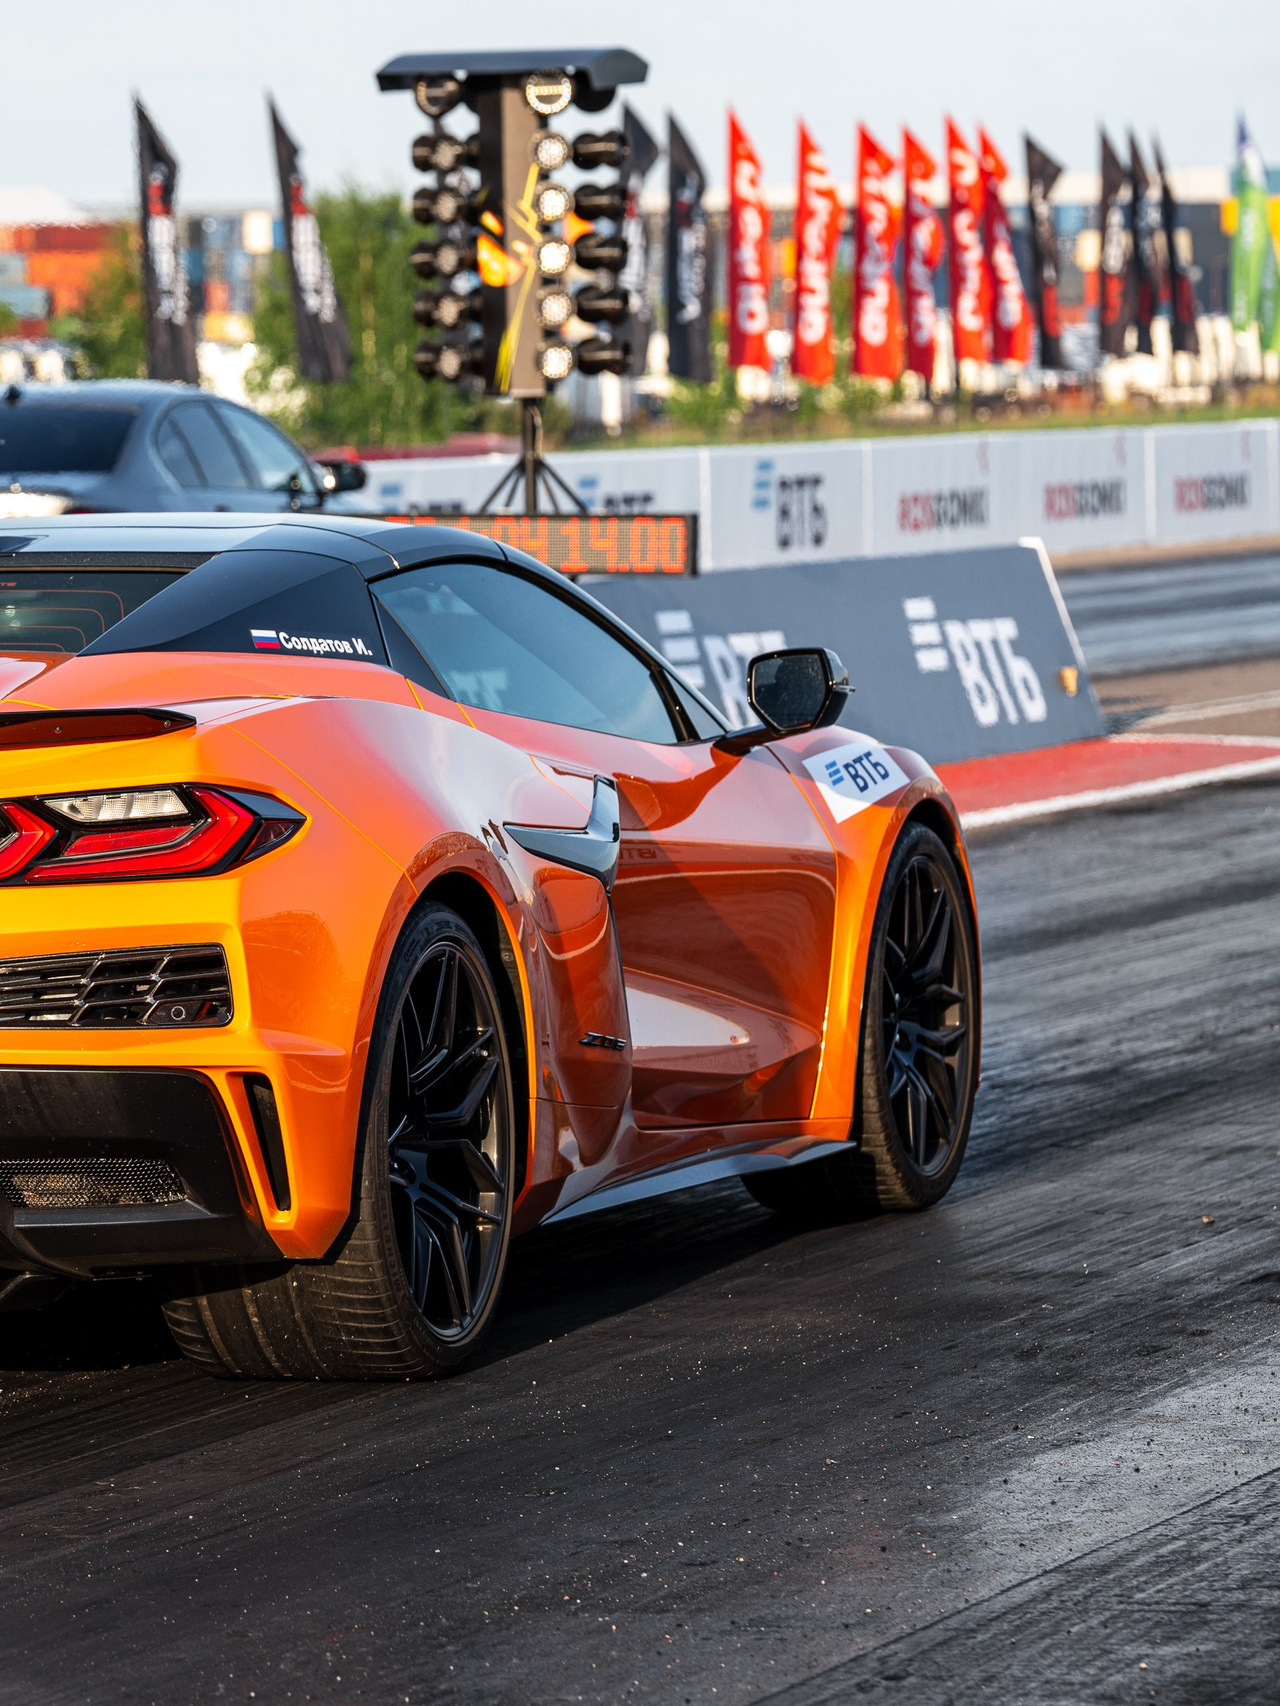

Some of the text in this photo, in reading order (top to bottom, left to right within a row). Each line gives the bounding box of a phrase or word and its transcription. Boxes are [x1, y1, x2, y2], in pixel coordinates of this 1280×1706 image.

[278, 631, 373, 656] Солдатов И.
[943, 617, 1047, 727] ВТБ
[843, 752, 891, 793] ВТБ
